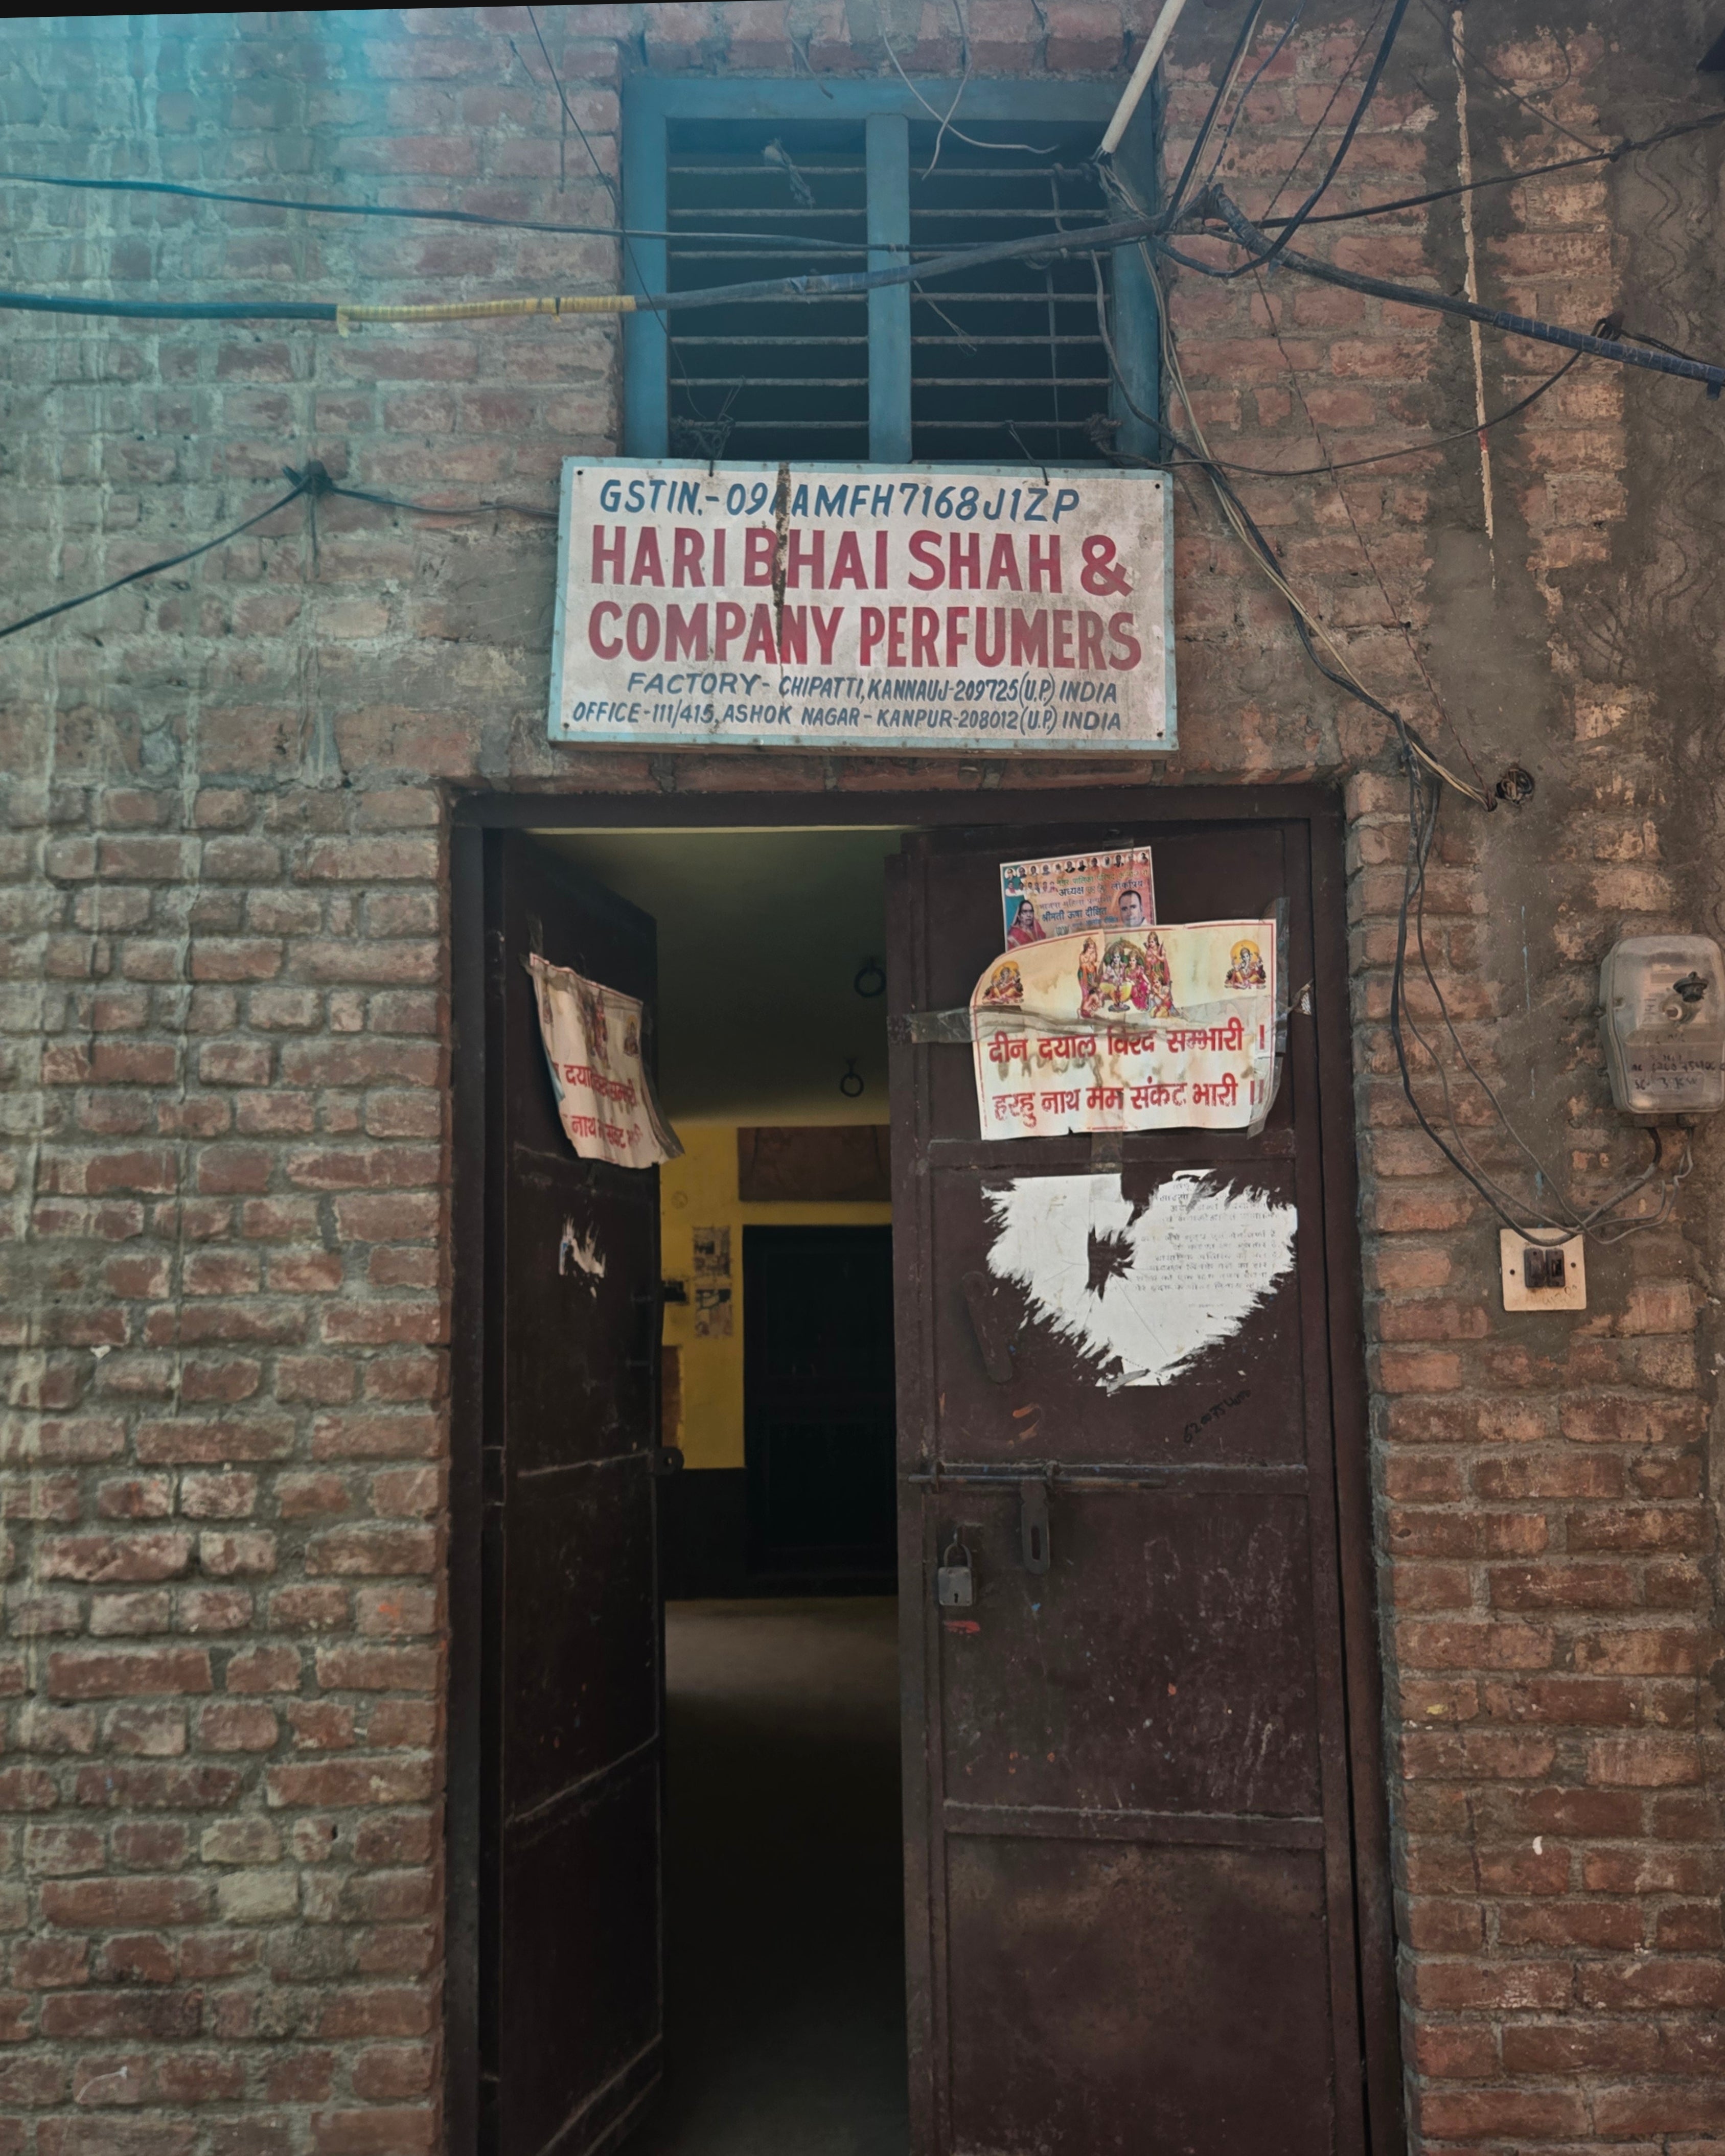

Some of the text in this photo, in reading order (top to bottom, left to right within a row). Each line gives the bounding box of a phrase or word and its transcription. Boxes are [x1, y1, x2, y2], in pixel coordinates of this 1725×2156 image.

[908, 529, 1063, 593] SHAH
[1080, 534, 1134, 597] &
[588, 600, 1142, 671] COMPANY PERFUMERS
[1059, 680, 1117, 704] INDIA
[723, 704, 793, 725] ASHOK
[1063, 711, 1121, 731] INDIA
[1059, 886, 1085, 896] अध्यक्ष
[1042, 910, 1065, 922] श्रीमती
[1086, 906, 1107, 918] दीक्षित
[987, 1030, 1028, 1063] दीन
[1037, 1033, 1098, 1061] दयाल
[1041, 1088, 1082, 1115] नाथ
[1086, 1087, 1124, 1111] मम
[1129, 1075, 1187, 1110] संकट
[1192, 1072, 1238, 1107] भारी
